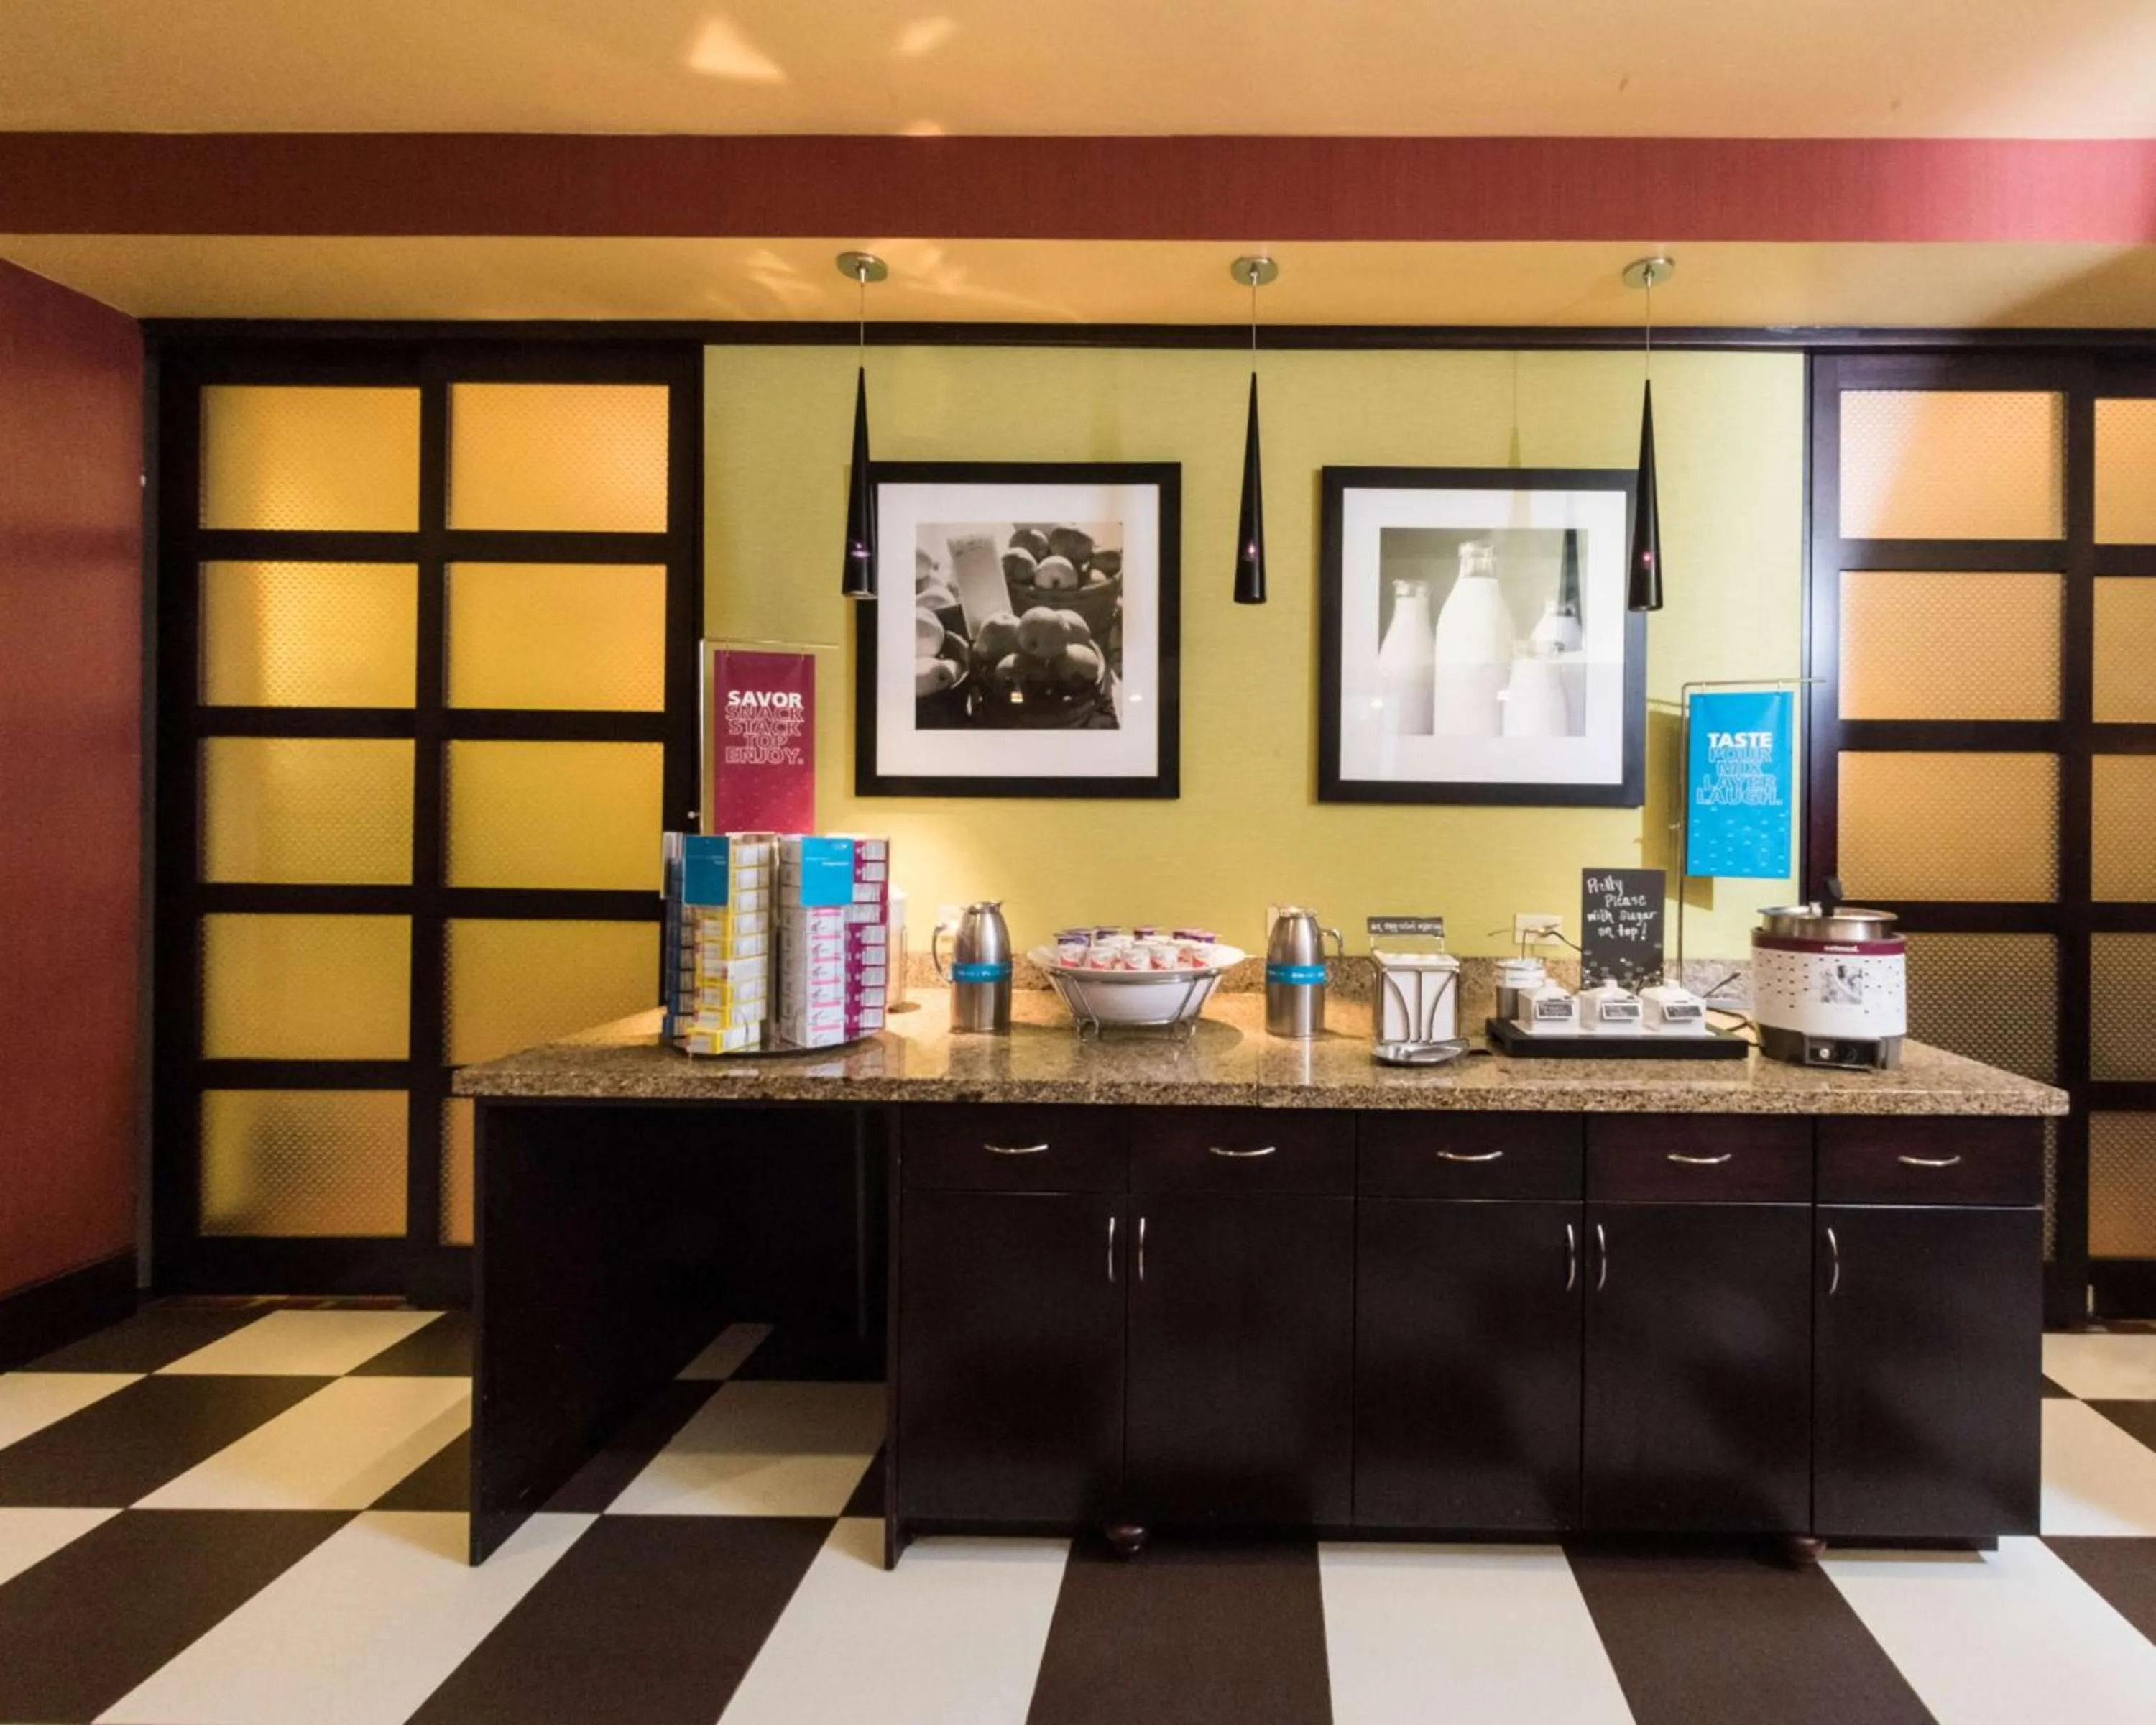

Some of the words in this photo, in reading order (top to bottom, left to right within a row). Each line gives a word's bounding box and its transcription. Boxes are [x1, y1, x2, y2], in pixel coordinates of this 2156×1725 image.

[727, 690, 803, 708] SAVOR
[724, 705, 804, 722] SNACK
[728, 719, 802, 737] STACK
[742, 732, 788, 749] TOP
[1706, 732, 1773, 748] TASTE
[725, 746, 805, 765] ENJOY.
[1716, 760, 1762, 776] MIX
[1703, 773, 1777, 791] LAYER
[1586, 875, 1623, 896] Pretty
[1586, 908, 1615, 924] with
[1598, 926, 1615, 939] on
